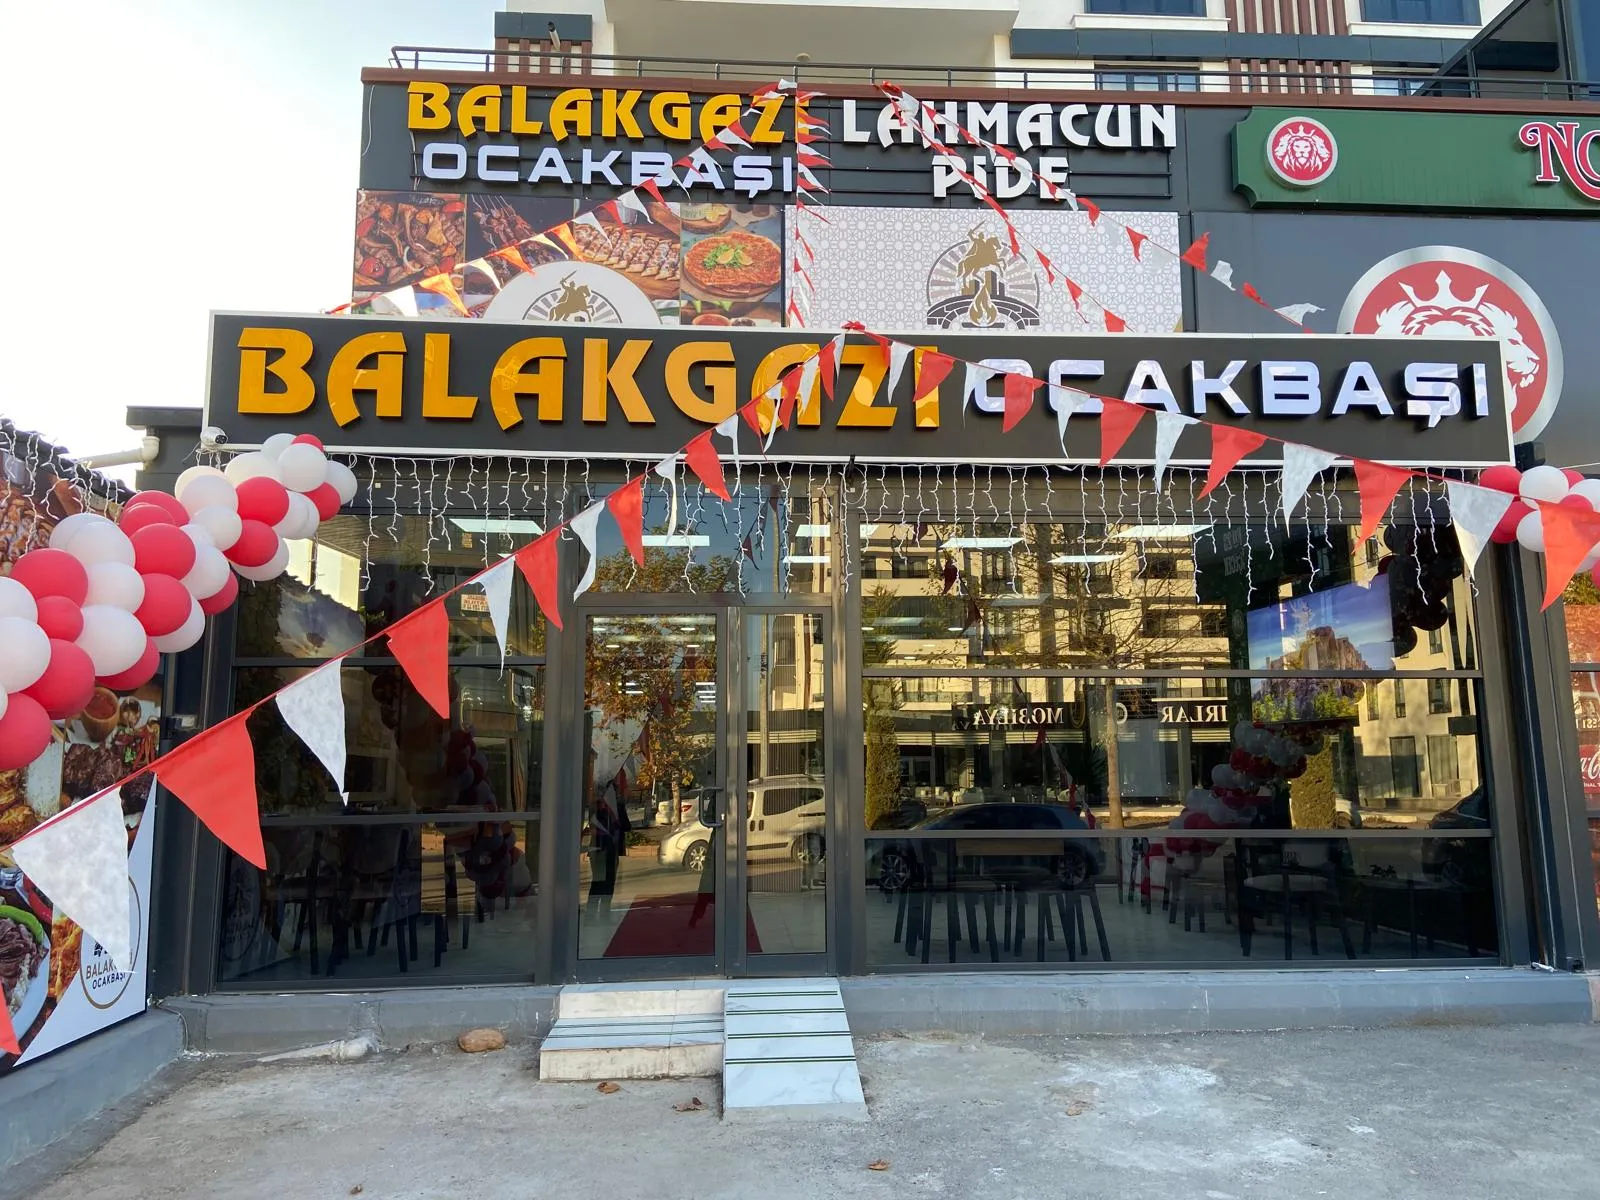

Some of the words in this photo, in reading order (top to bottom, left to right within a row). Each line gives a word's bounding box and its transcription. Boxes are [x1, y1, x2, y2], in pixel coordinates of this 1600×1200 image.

[843, 99, 1177, 151] LAHMACUN
[422, 143, 792, 198] OCAKBAŞI
[974, 358, 1489, 428] OCAKBAŞI
